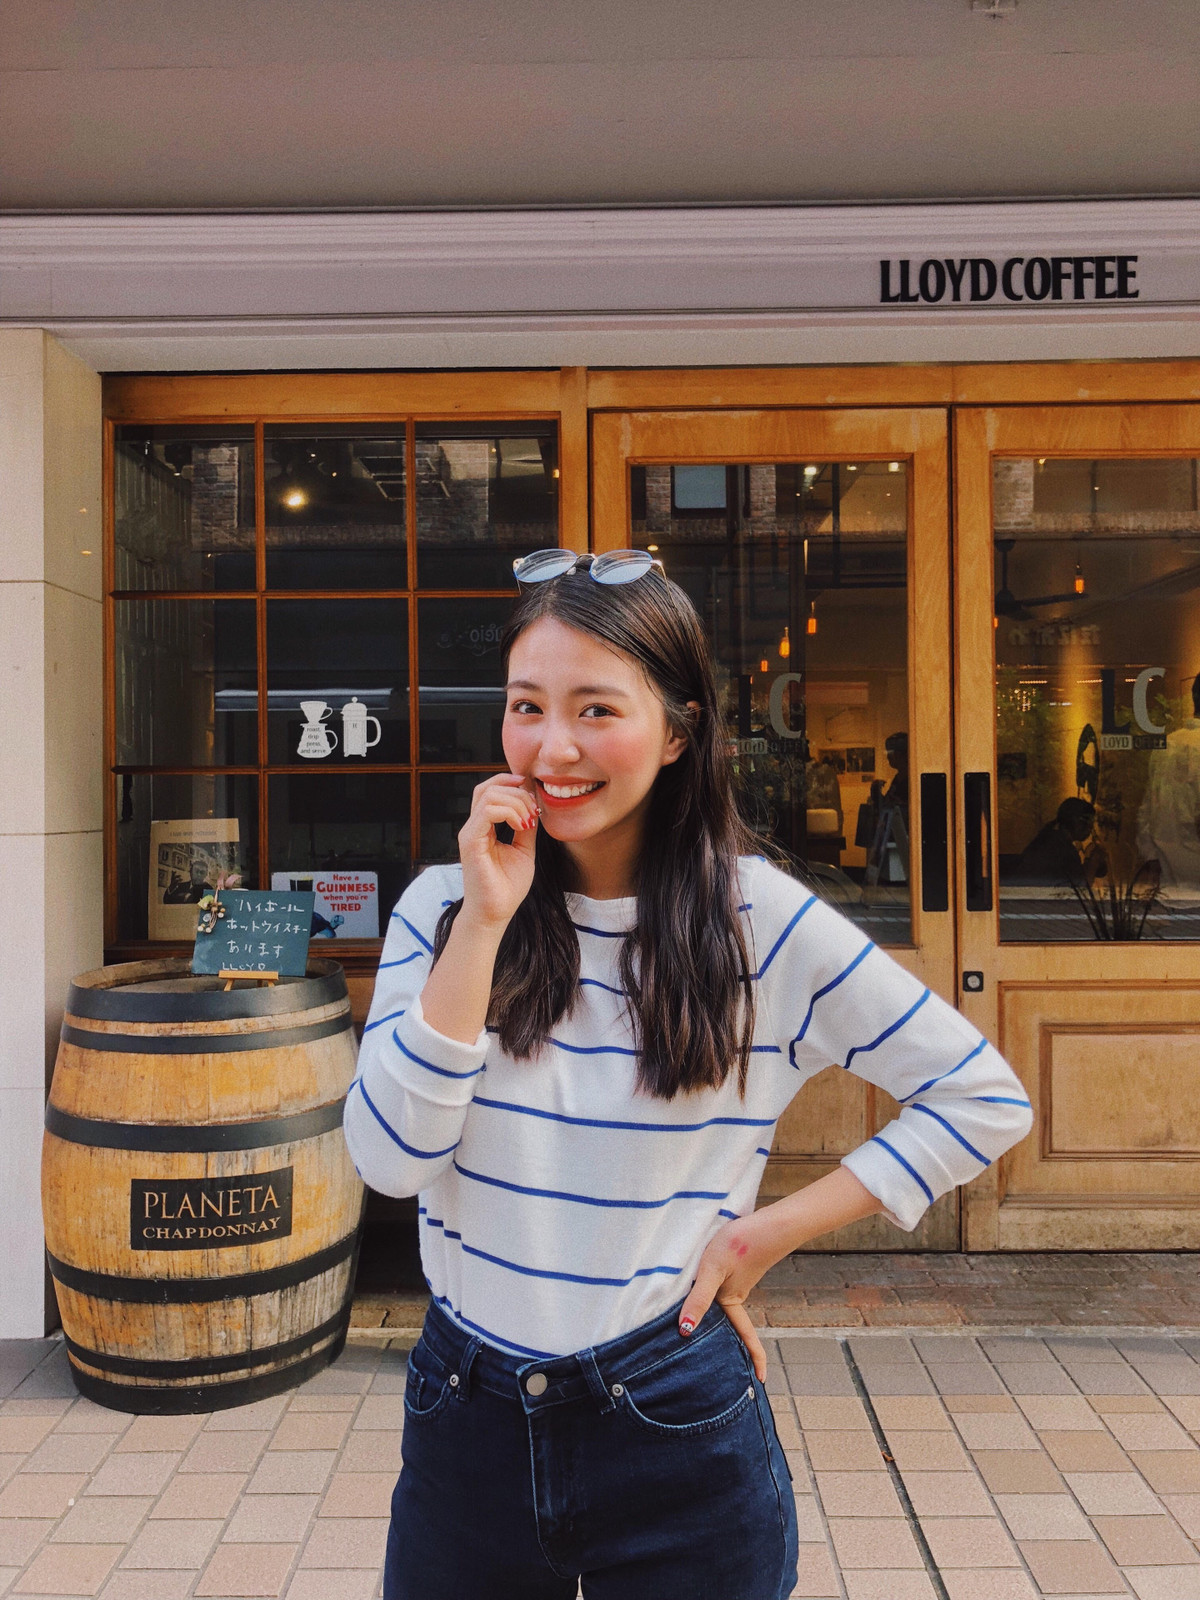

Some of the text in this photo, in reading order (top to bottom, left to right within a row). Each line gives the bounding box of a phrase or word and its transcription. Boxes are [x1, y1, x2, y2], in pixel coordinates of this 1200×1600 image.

[880, 255, 1140, 303] LLOYD COFFEE
[316, 881, 376, 893] GUINNESS
[330, 903, 362, 912] TIRED
[226, 940, 284, 959] あります
[143, 1184, 281, 1219] PLANETA
